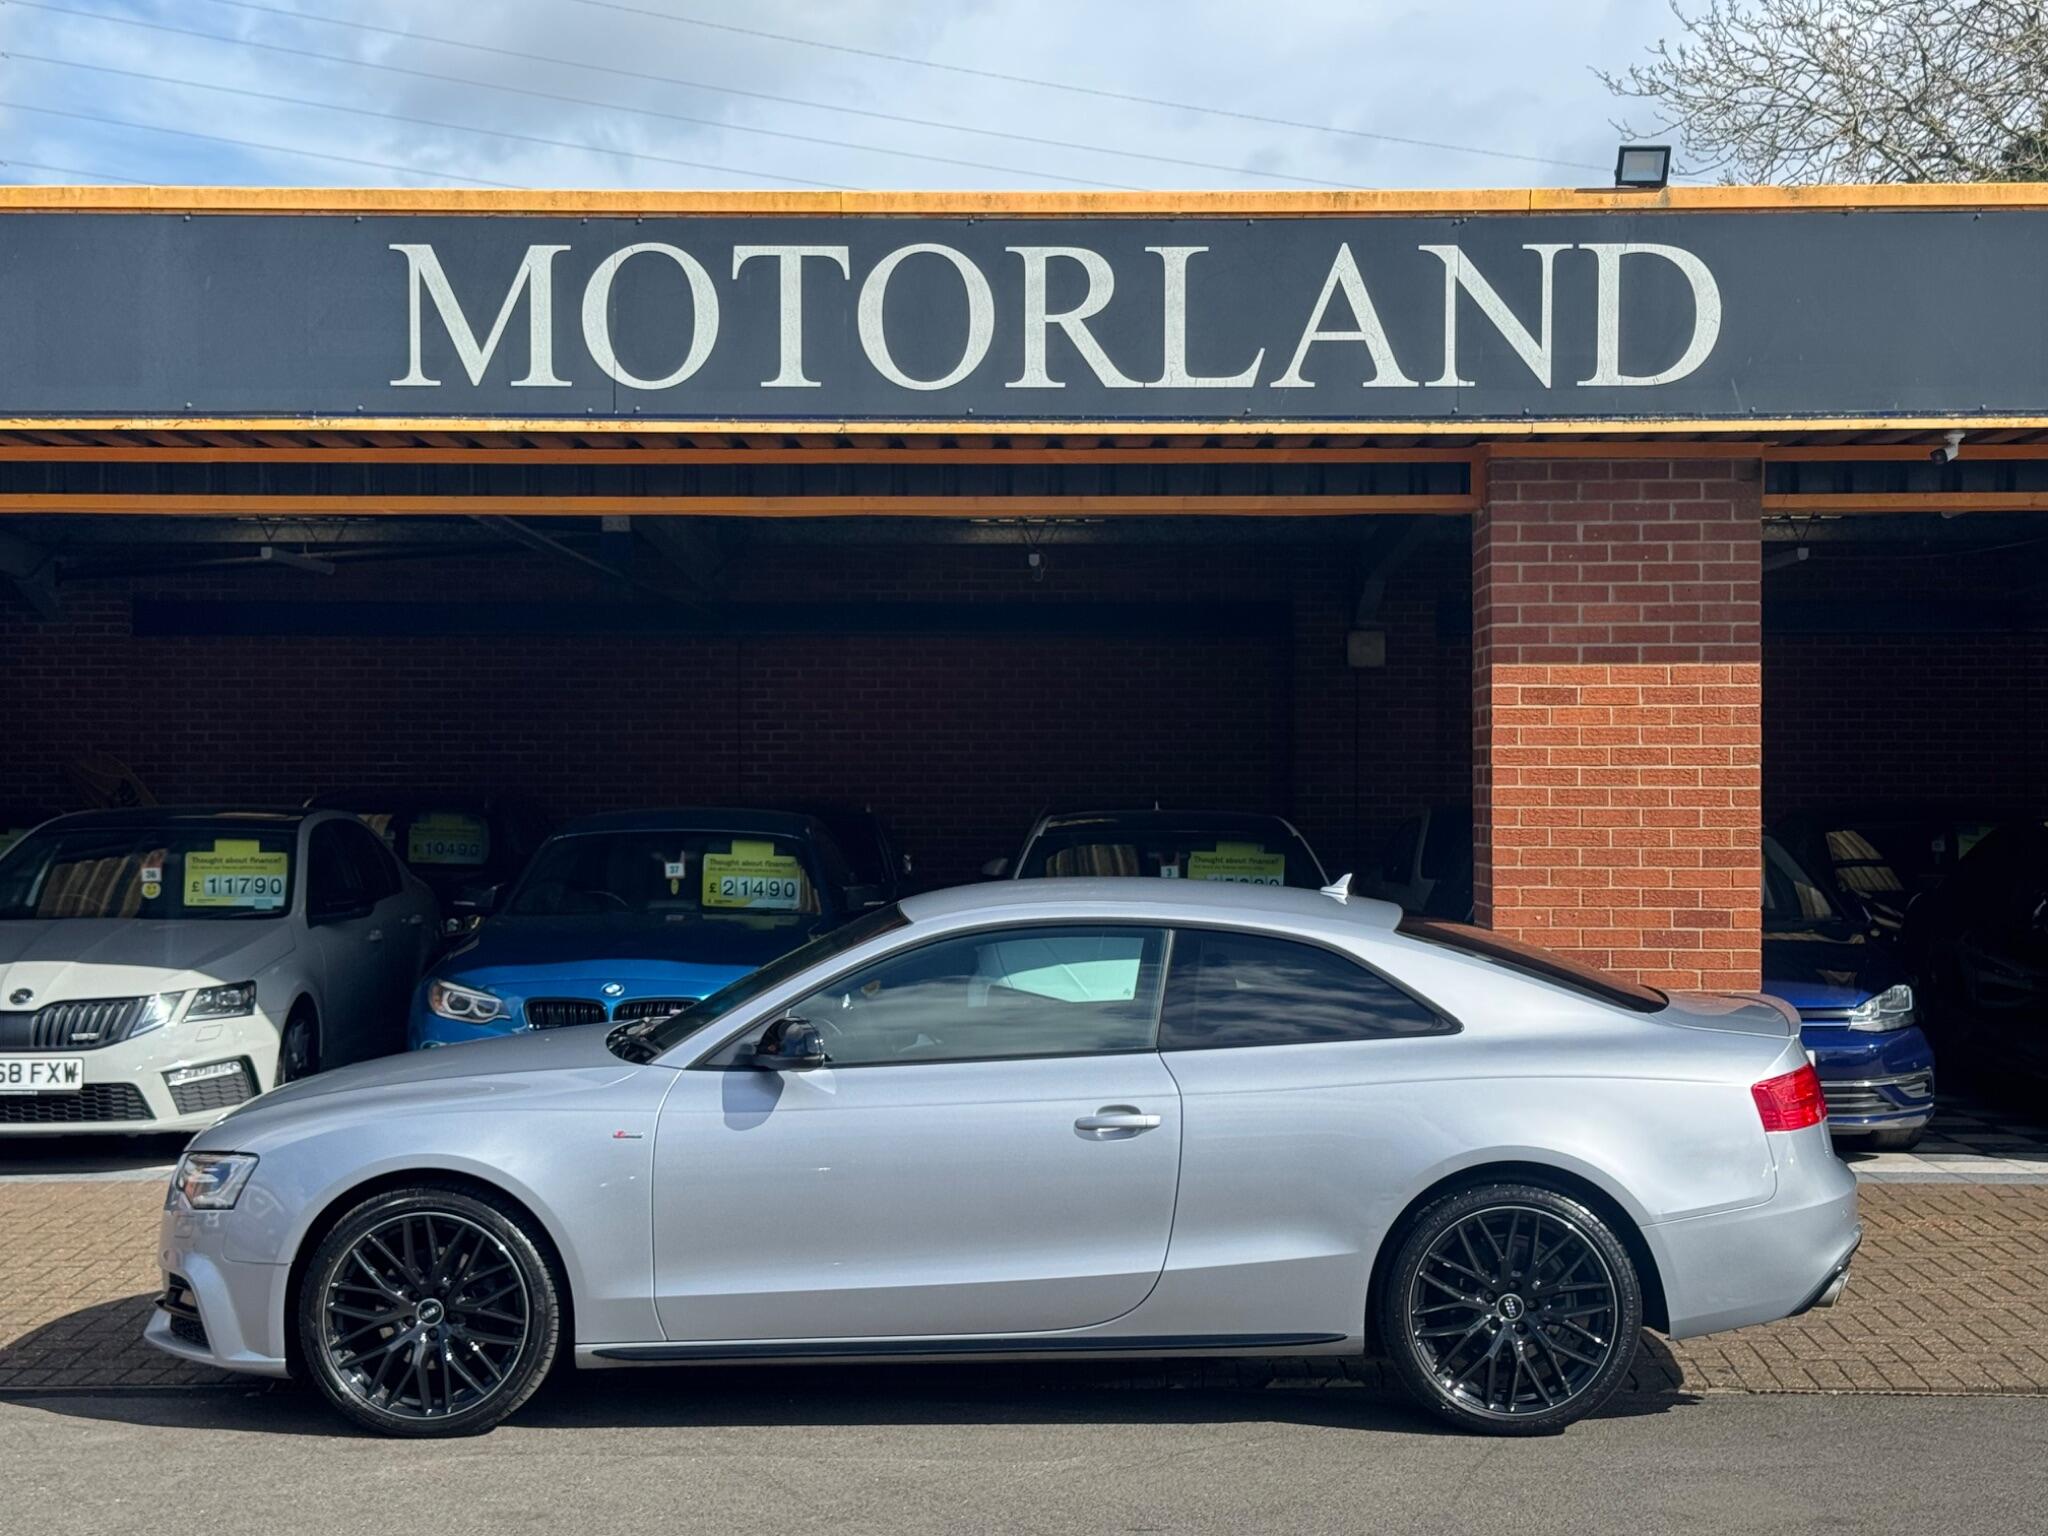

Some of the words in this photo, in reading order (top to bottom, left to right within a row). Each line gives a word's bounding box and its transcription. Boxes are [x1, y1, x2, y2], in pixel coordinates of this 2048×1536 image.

[389, 241, 1723, 390] MOTORLAND
[191, 856, 223, 865] Thought
[225, 856, 248, 864] about
[741, 859, 763, 868] about
[208, 877, 283, 895] 11790
[709, 882, 717, 894] £
[722, 879, 796, 898] 21490
[30, 1062, 78, 1084] FXW
